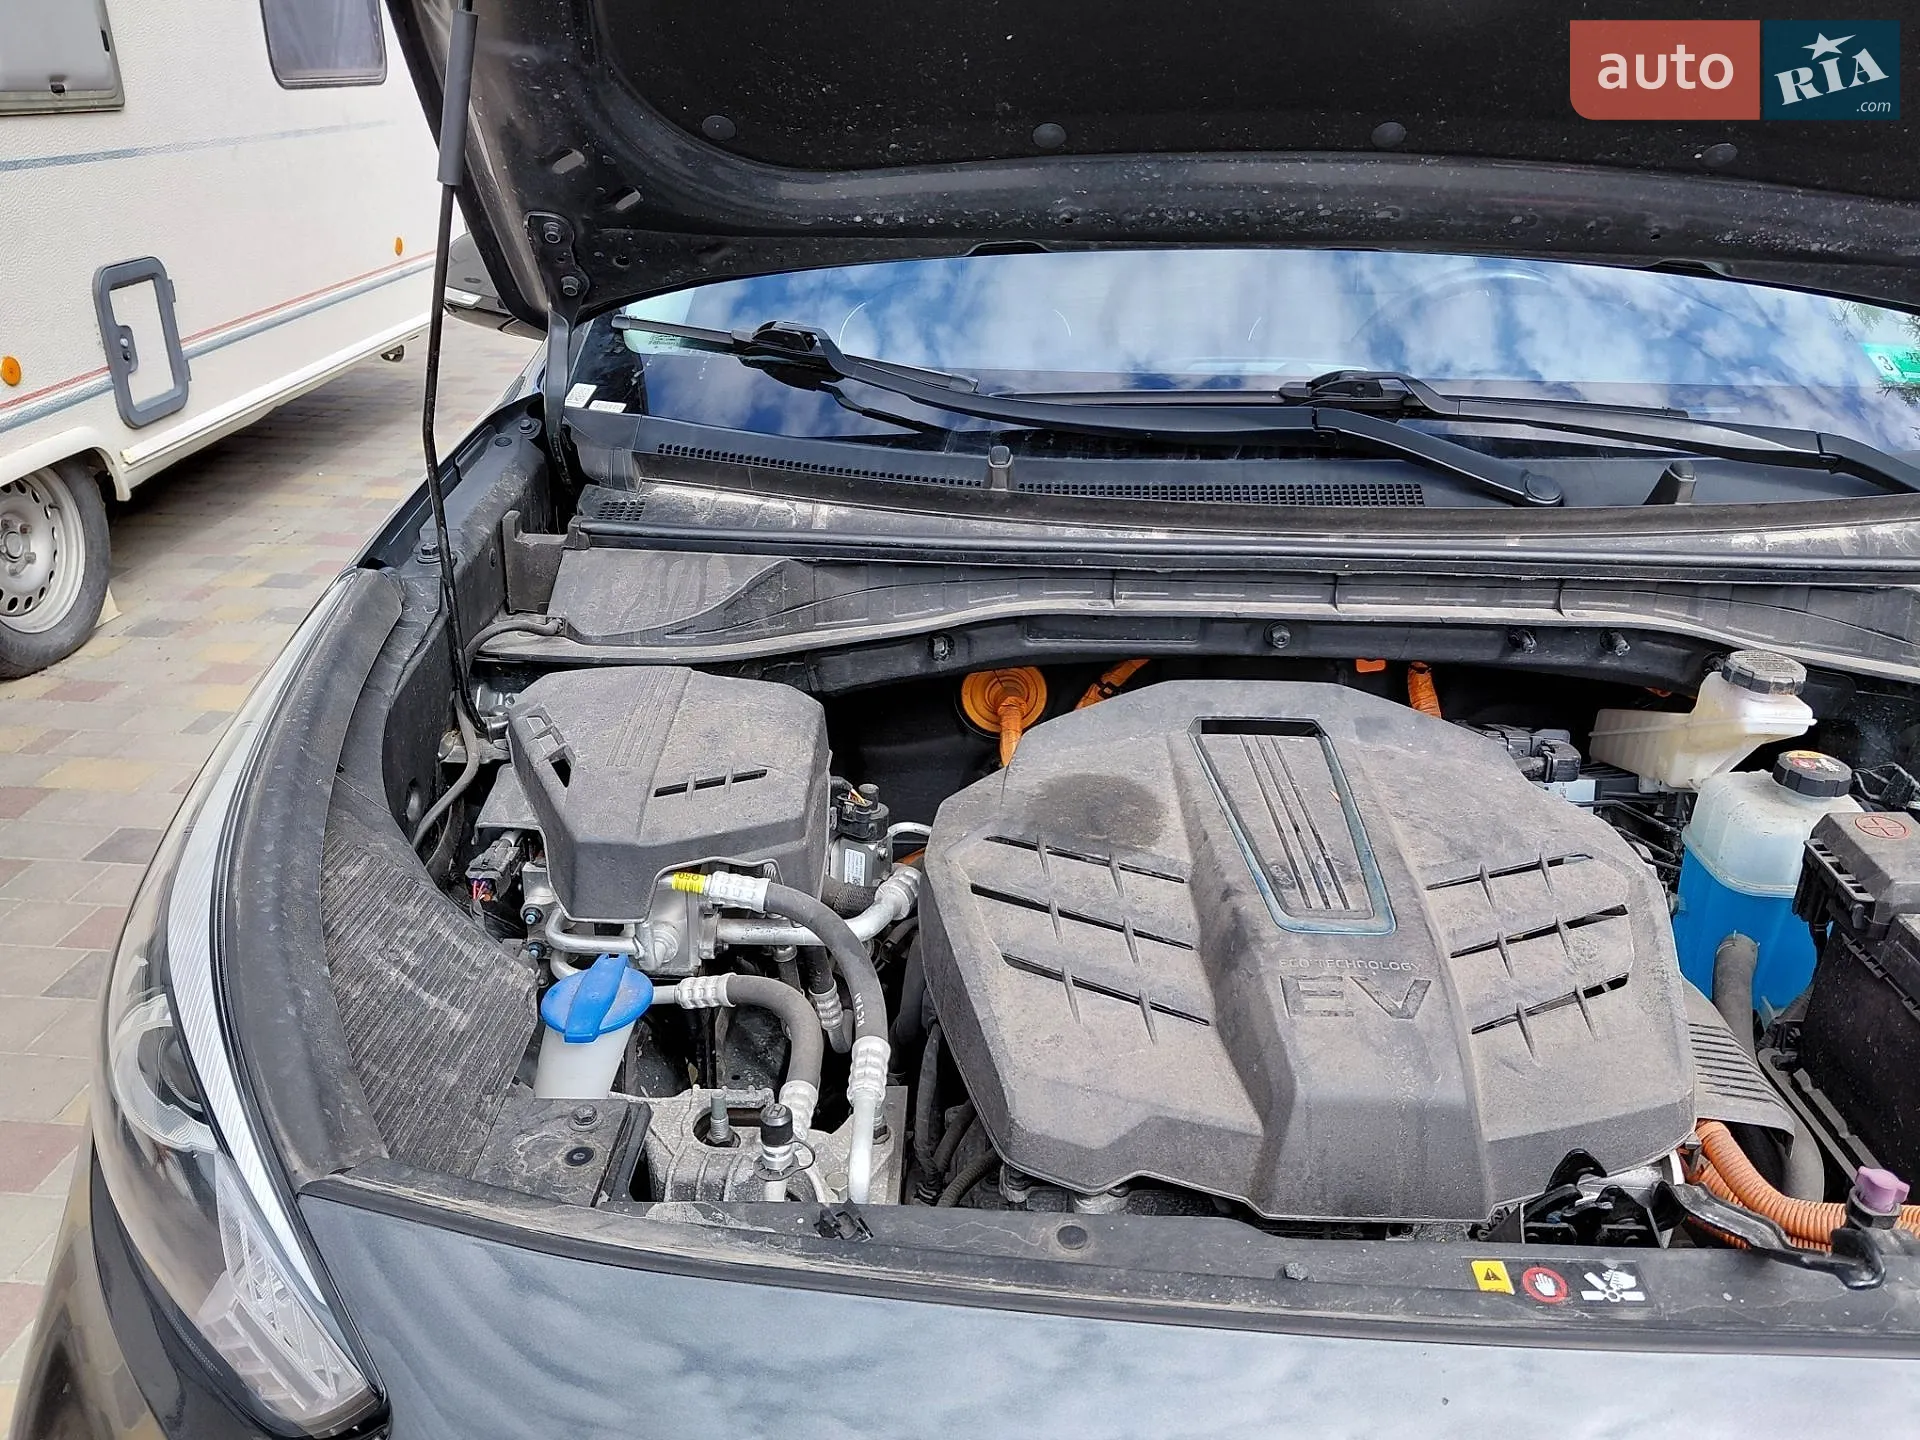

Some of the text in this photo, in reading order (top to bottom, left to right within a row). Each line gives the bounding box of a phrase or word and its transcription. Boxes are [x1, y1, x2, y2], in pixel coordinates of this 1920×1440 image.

[1877, 355, 1894, 371] 3
[1279, 959, 1310, 969] ECO
[1280, 975, 1432, 1019] EV
